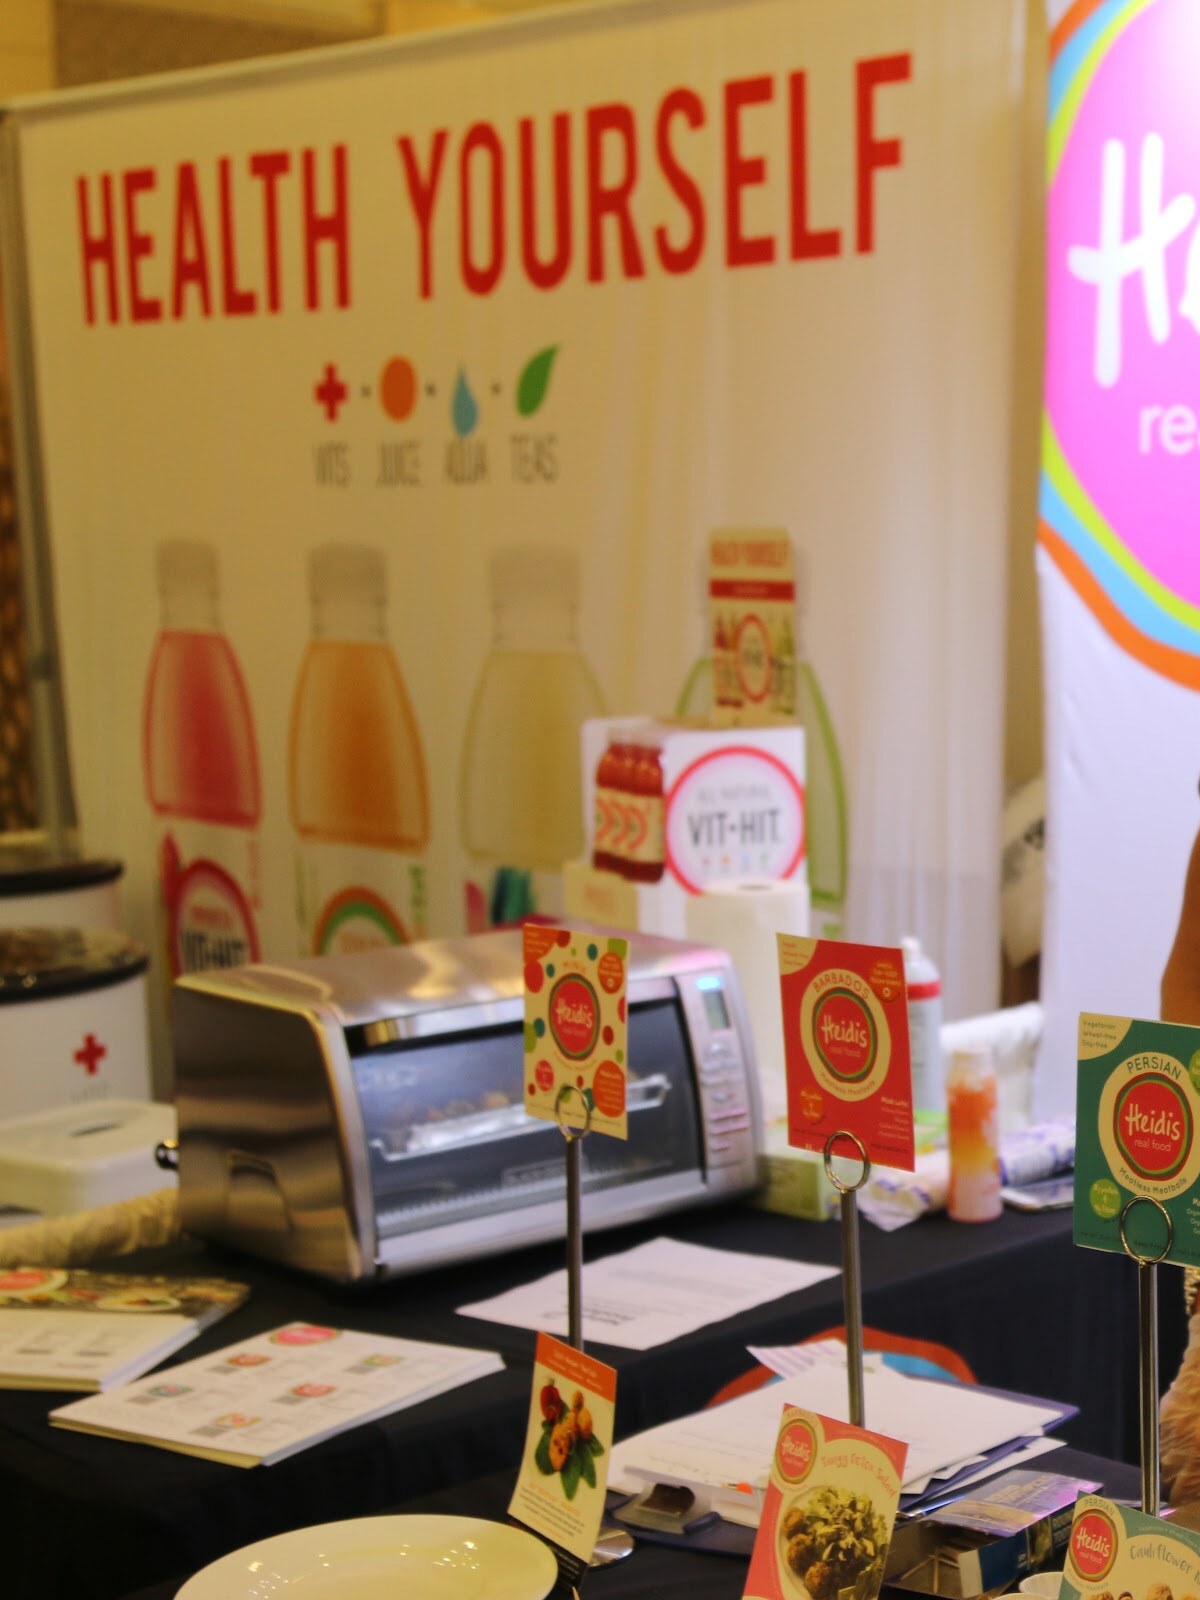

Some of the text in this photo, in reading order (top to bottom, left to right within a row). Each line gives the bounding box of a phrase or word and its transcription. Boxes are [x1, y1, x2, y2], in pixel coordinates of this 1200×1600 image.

[76, 53, 912, 327] HEALTH YOURSELF
[812, 972, 871, 1001] BARBADOS
[1083, 1021, 1116, 1030] Vegetarian
[1083, 1031, 1117, 1041] Wheat-free
[1081, 1040, 1108, 1049] Soy-free
[1126, 1056, 1182, 1081] PERSIAN
[1134, 1139, 1172, 1151] real food
[1119, 1168, 1188, 1194] Meatless Meatballs
[1085, 1499, 1115, 1517] PERSIAN
[1130, 1543, 1192, 1575] Cauliflower
